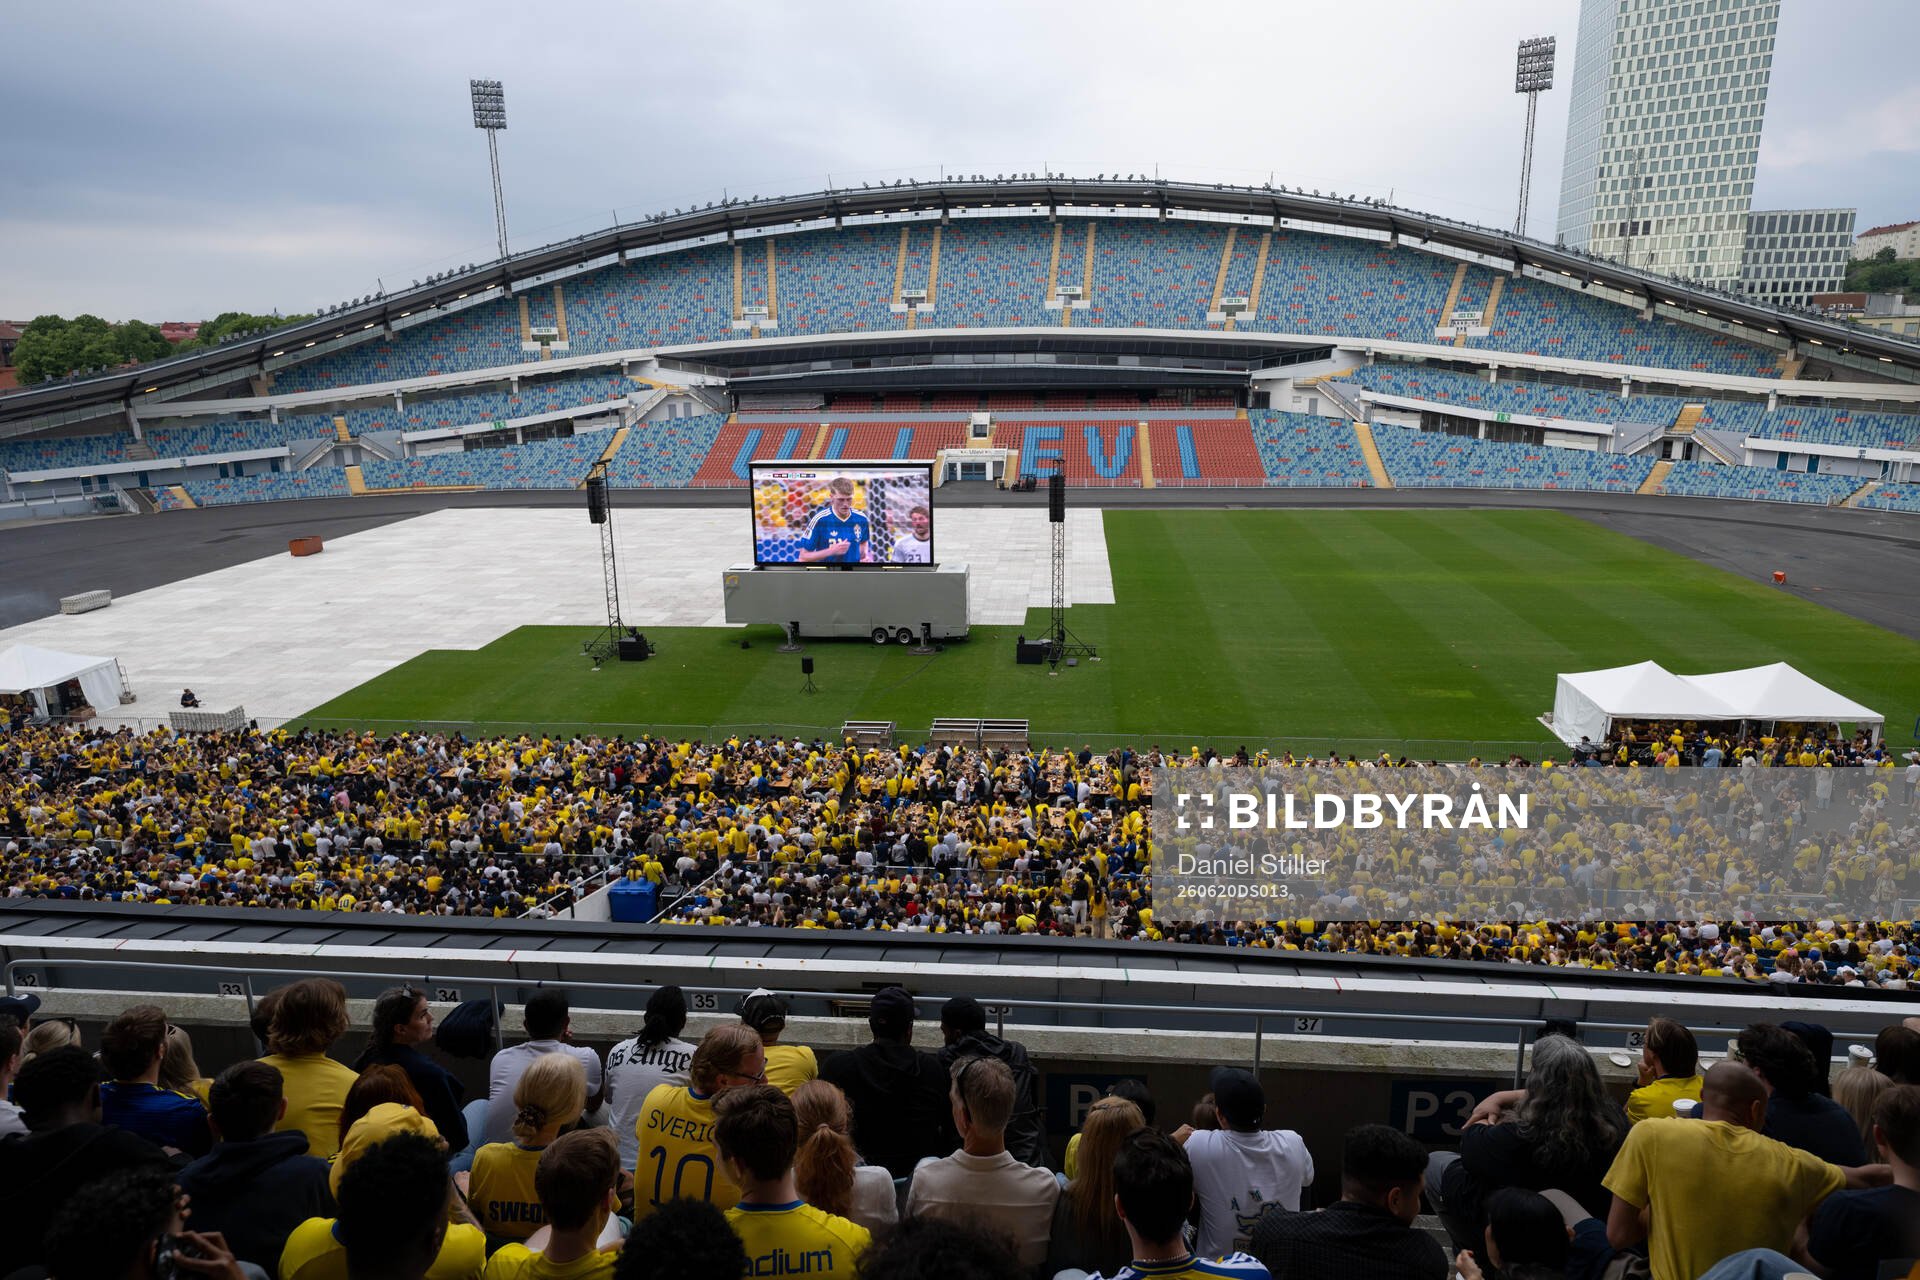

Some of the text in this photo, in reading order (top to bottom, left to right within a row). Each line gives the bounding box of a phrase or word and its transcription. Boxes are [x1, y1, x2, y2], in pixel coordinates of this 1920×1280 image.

[438, 989, 458, 1003] 34
[695, 994, 715, 1008] 35
[1297, 1017, 1319, 1030] 37
[1406, 1090, 1476, 1137] P3
[650, 1146, 714, 1205] 10
[488, 1200, 547, 1224] SWED
